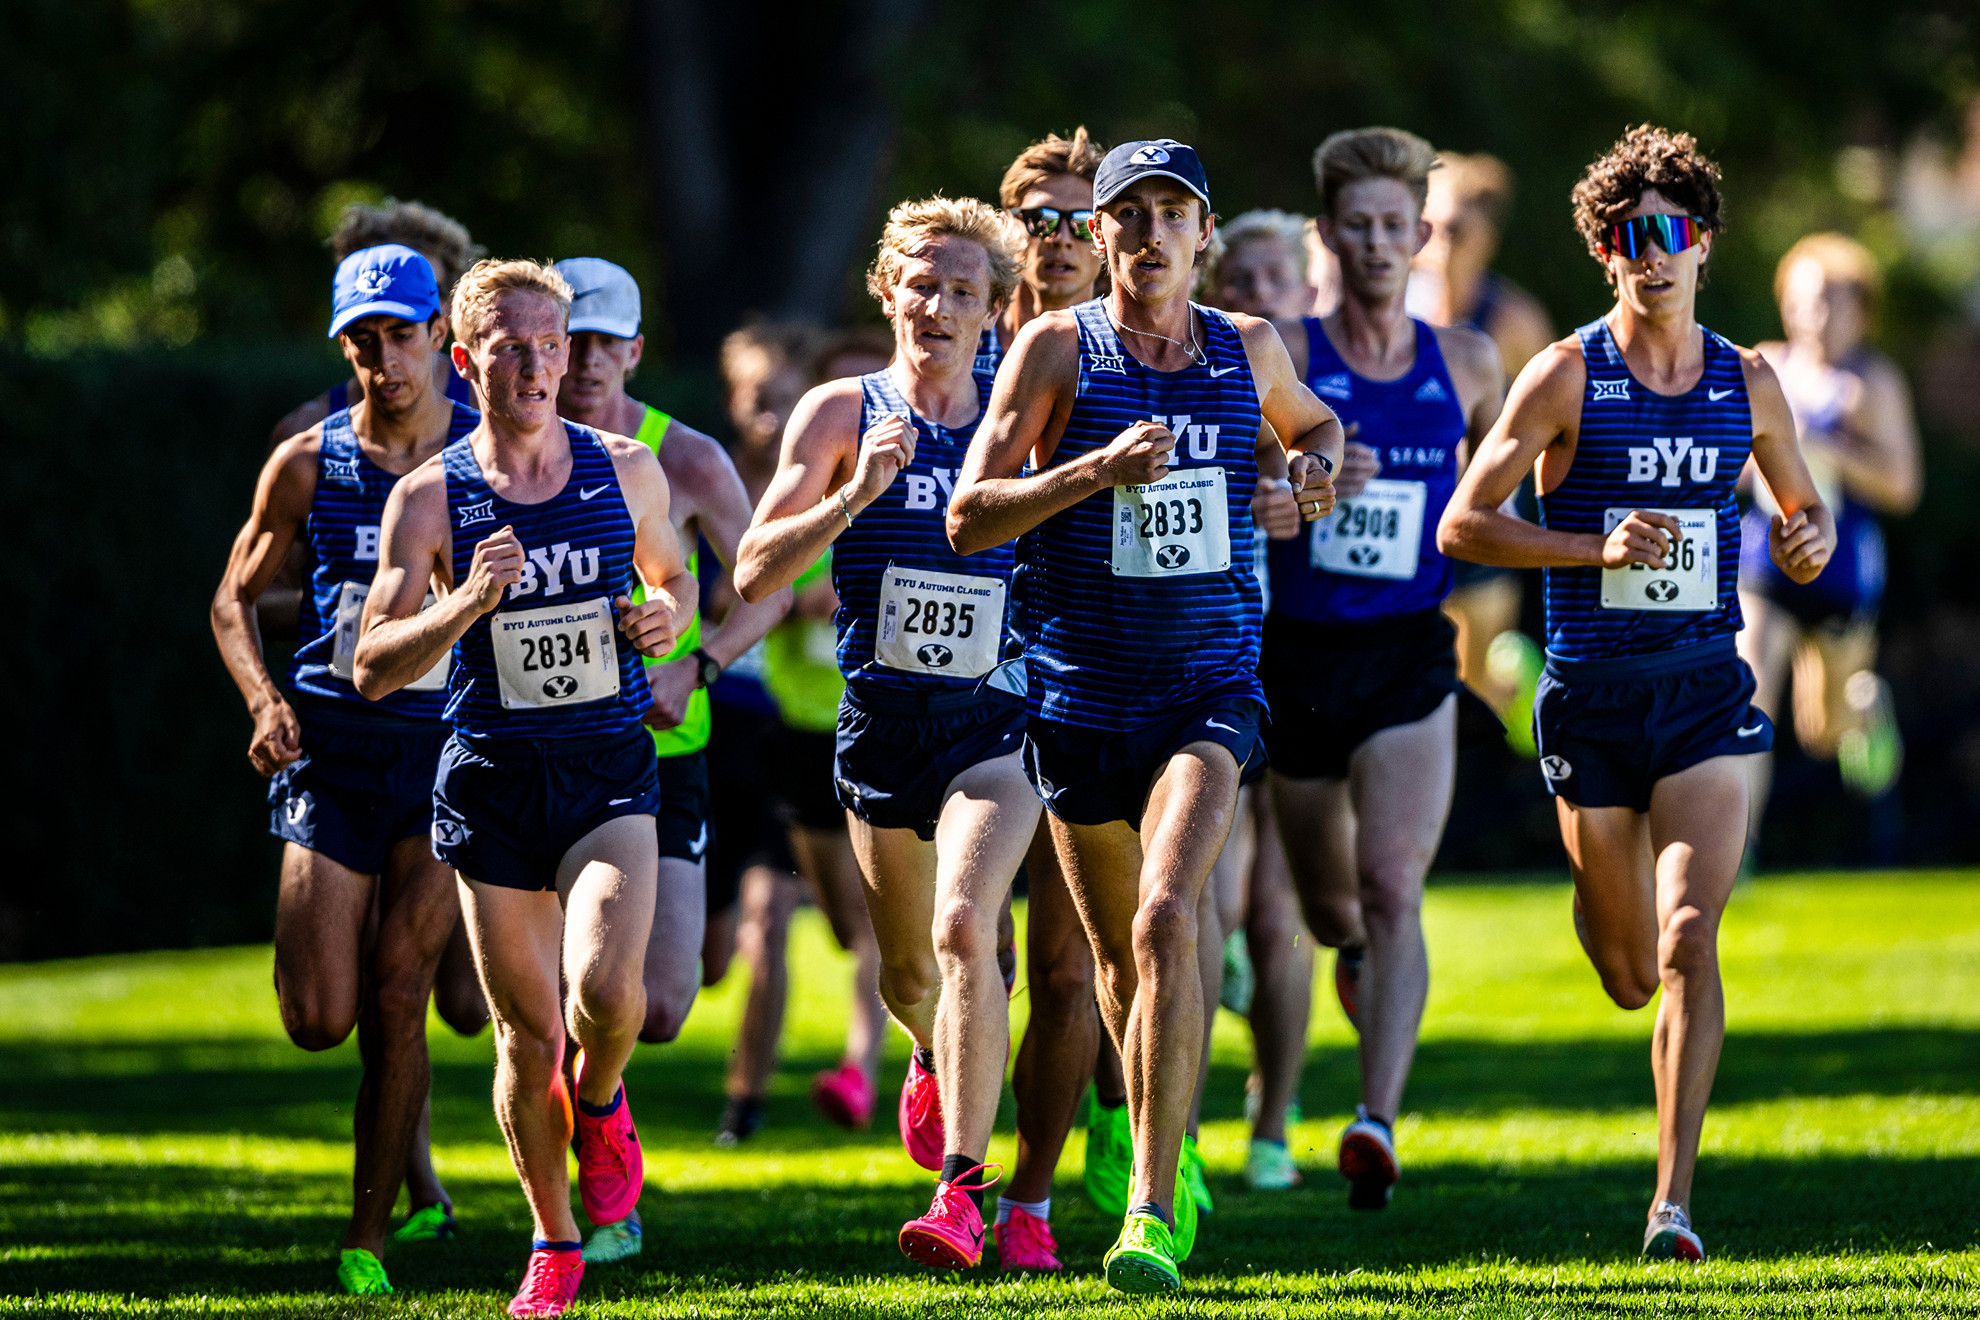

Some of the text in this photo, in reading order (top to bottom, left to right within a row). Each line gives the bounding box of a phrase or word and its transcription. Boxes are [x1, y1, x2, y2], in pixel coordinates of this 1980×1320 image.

[1129, 414, 1220, 466] YU
[1627, 437, 1719, 487] BYU
[1125, 480, 1214, 494] BYU AUTUMN CLASSIC
[1140, 498, 1203, 538] 2833
[1335, 503, 1400, 541] 2908
[510, 542, 600, 600] BYU
[1630, 537, 1694, 571] 36
[894, 578, 991, 596] BYU AUTUMN CLASSIC
[503, 611, 599, 631] BYU AUTUMN CLASSIC
[903, 597, 975, 638] 2835
[520, 630, 590, 672] 2834
